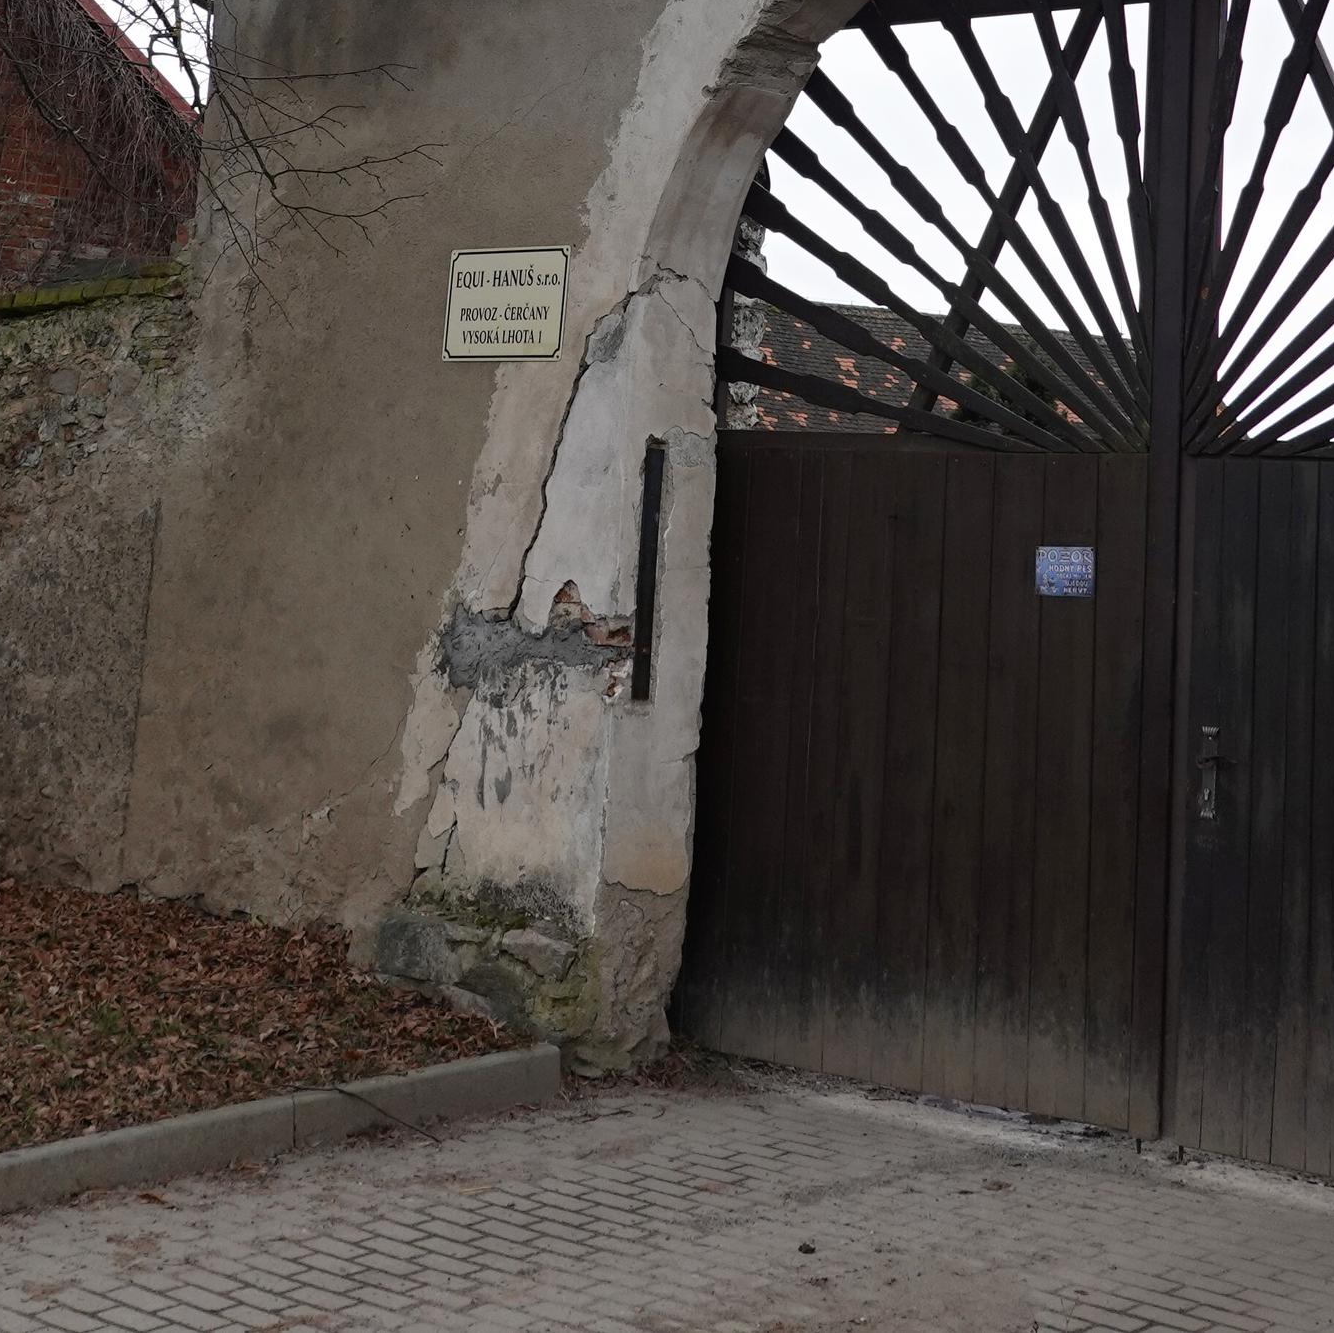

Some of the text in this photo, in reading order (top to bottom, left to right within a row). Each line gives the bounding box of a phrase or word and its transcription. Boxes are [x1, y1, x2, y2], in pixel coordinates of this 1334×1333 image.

[456, 271, 484, 289] EQUI
[492, 264, 534, 287] HANUŠ
[536, 273, 561, 286] s.r.o.
[460, 307, 498, 322] PROVOZ
[504, 303, 550, 321] ČERČANY
[462, 326, 500, 345] VYSOKÁ
[502, 329, 535, 344] LHOTA
